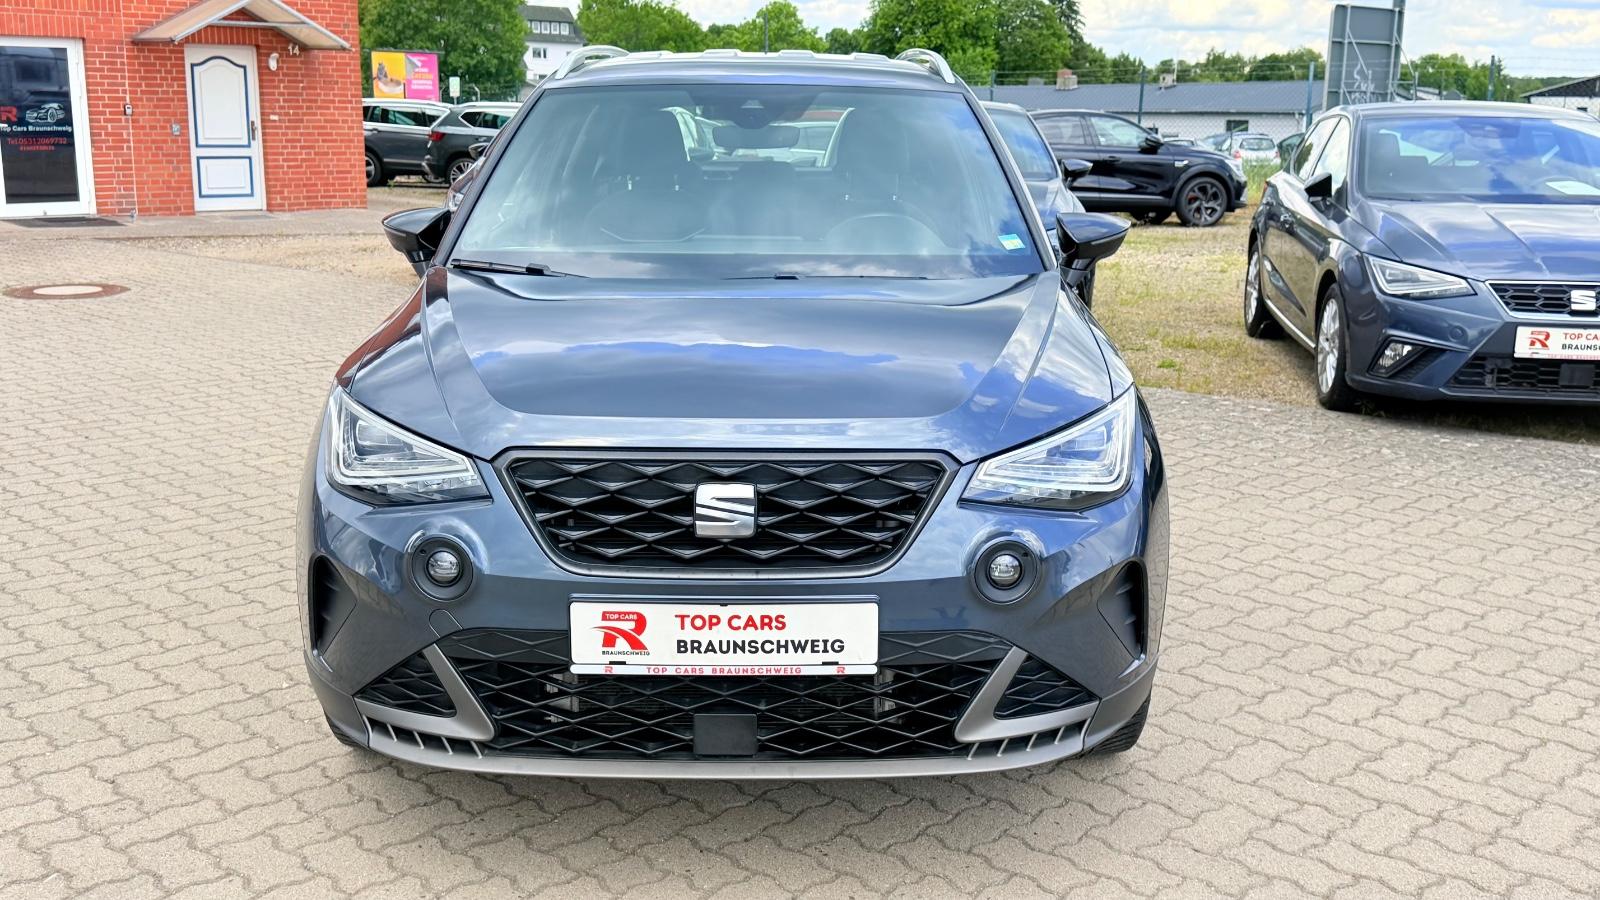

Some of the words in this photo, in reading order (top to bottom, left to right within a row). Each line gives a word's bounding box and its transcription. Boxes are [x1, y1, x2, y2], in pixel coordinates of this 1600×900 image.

[288, 43, 300, 56] 14
[28, 125, 72, 133] Braunschweig
[1563, 332, 1583, 341] TOP
[1585, 333, 1600, 341] CA
[675, 614, 721, 631] TOP
[727, 614, 787, 631] CARS
[676, 639, 845, 655] BRAUNSCHWEIG
